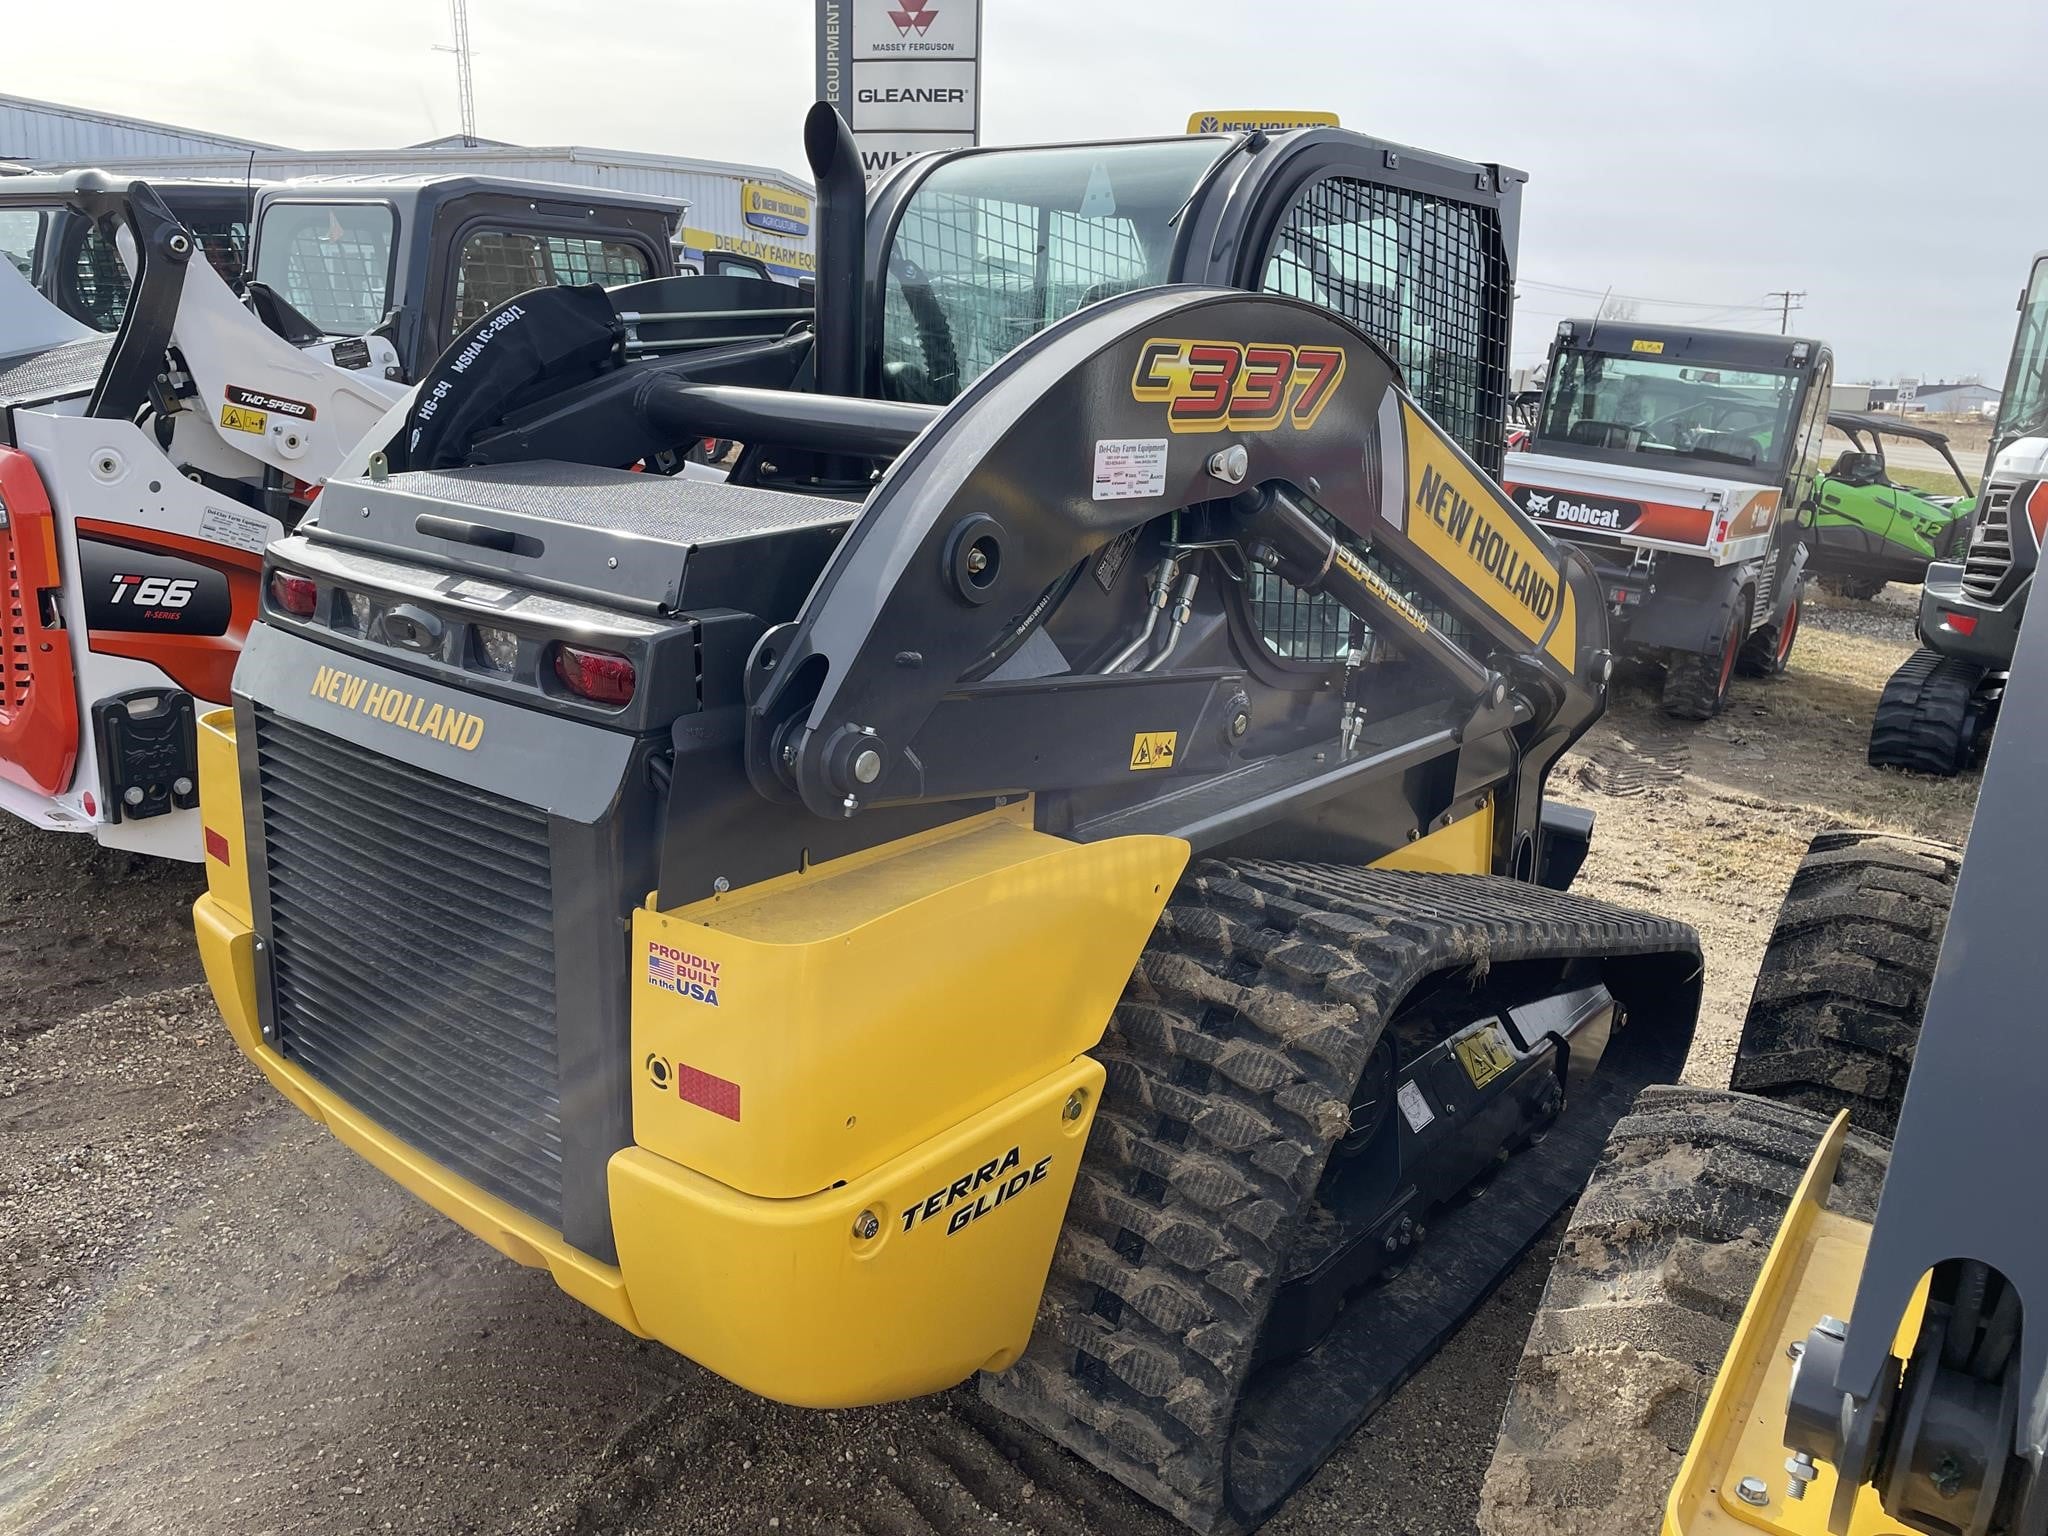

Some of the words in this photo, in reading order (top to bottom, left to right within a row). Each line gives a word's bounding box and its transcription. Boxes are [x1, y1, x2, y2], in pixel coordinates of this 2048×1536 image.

[827, 1, 840, 102] EQUIPMENT
[872, 43, 906, 51] MASSEY
[908, 43, 955, 51] FERGUSON
[858, 89, 964, 103] GLEANER
[761, 198, 778, 212] NEW
[778, 201, 806, 219] HOLLAND
[762, 215, 799, 232] AGRICULTURE
[714, 235, 768, 259] DEL-CLAY
[770, 246, 797, 265] FARM
[451, 341, 485, 374] MSHA
[1132, 339, 1346, 428] C337
[240, 392, 307, 415] TWO-SPEED
[418, 380, 453, 421] HG-64
[1122, 445, 1136, 453] Farm
[1556, 500, 1621, 529] Bobcat
[1416, 463, 1475, 546] NEW
[1468, 514, 1555, 623] HOLLAND
[111, 574, 199, 609] T66
[144, 610, 182, 621] R-SERIES
[310, 665, 368, 711] NEW
[362, 682, 485, 751] HOLLAND
[649, 941, 720, 974] PROUDLY
[648, 975, 658, 986] in
[659, 978, 675, 992] the
[676, 978, 719, 1007] USA
[676, 964, 720, 988] BUILT
[901, 1145, 1020, 1233] TERRA
[946, 1154, 1053, 1237] GLIDE
